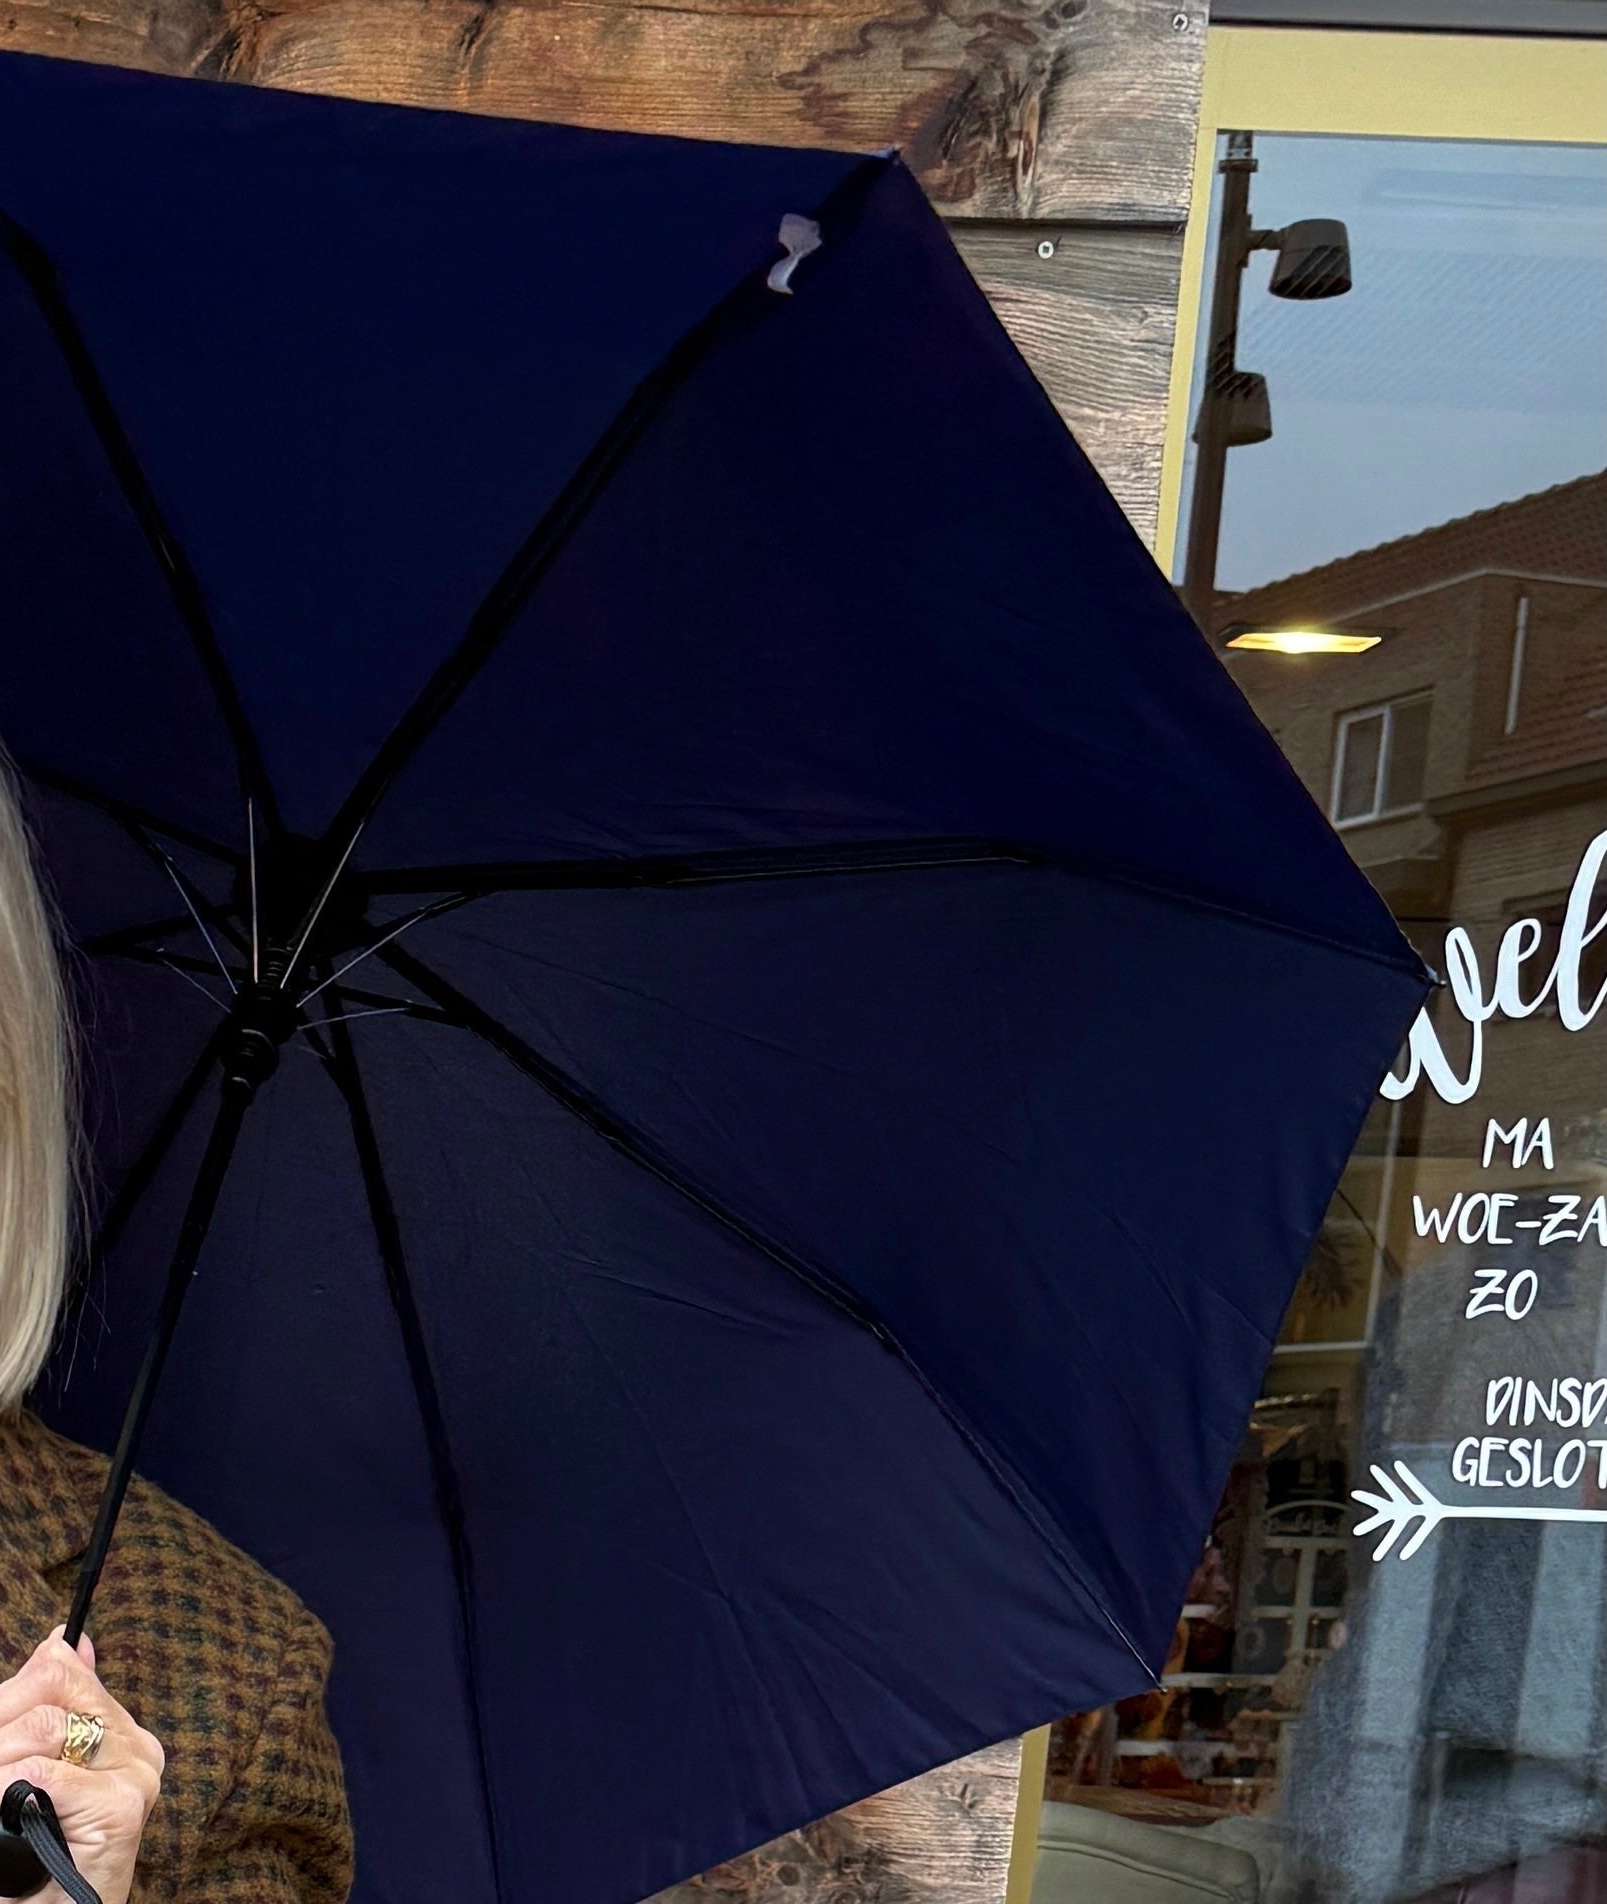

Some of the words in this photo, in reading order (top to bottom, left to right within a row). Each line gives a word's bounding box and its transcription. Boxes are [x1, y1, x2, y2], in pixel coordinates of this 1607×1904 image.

[1483, 1118, 1553, 1169] MA
[1413, 1193, 1607, 1246] WOE-ZA
[1466, 1270, 1537, 1320] ZO
[1487, 1377, 1607, 1427] DINSD
[1453, 1437, 1607, 1489] GESLOT
